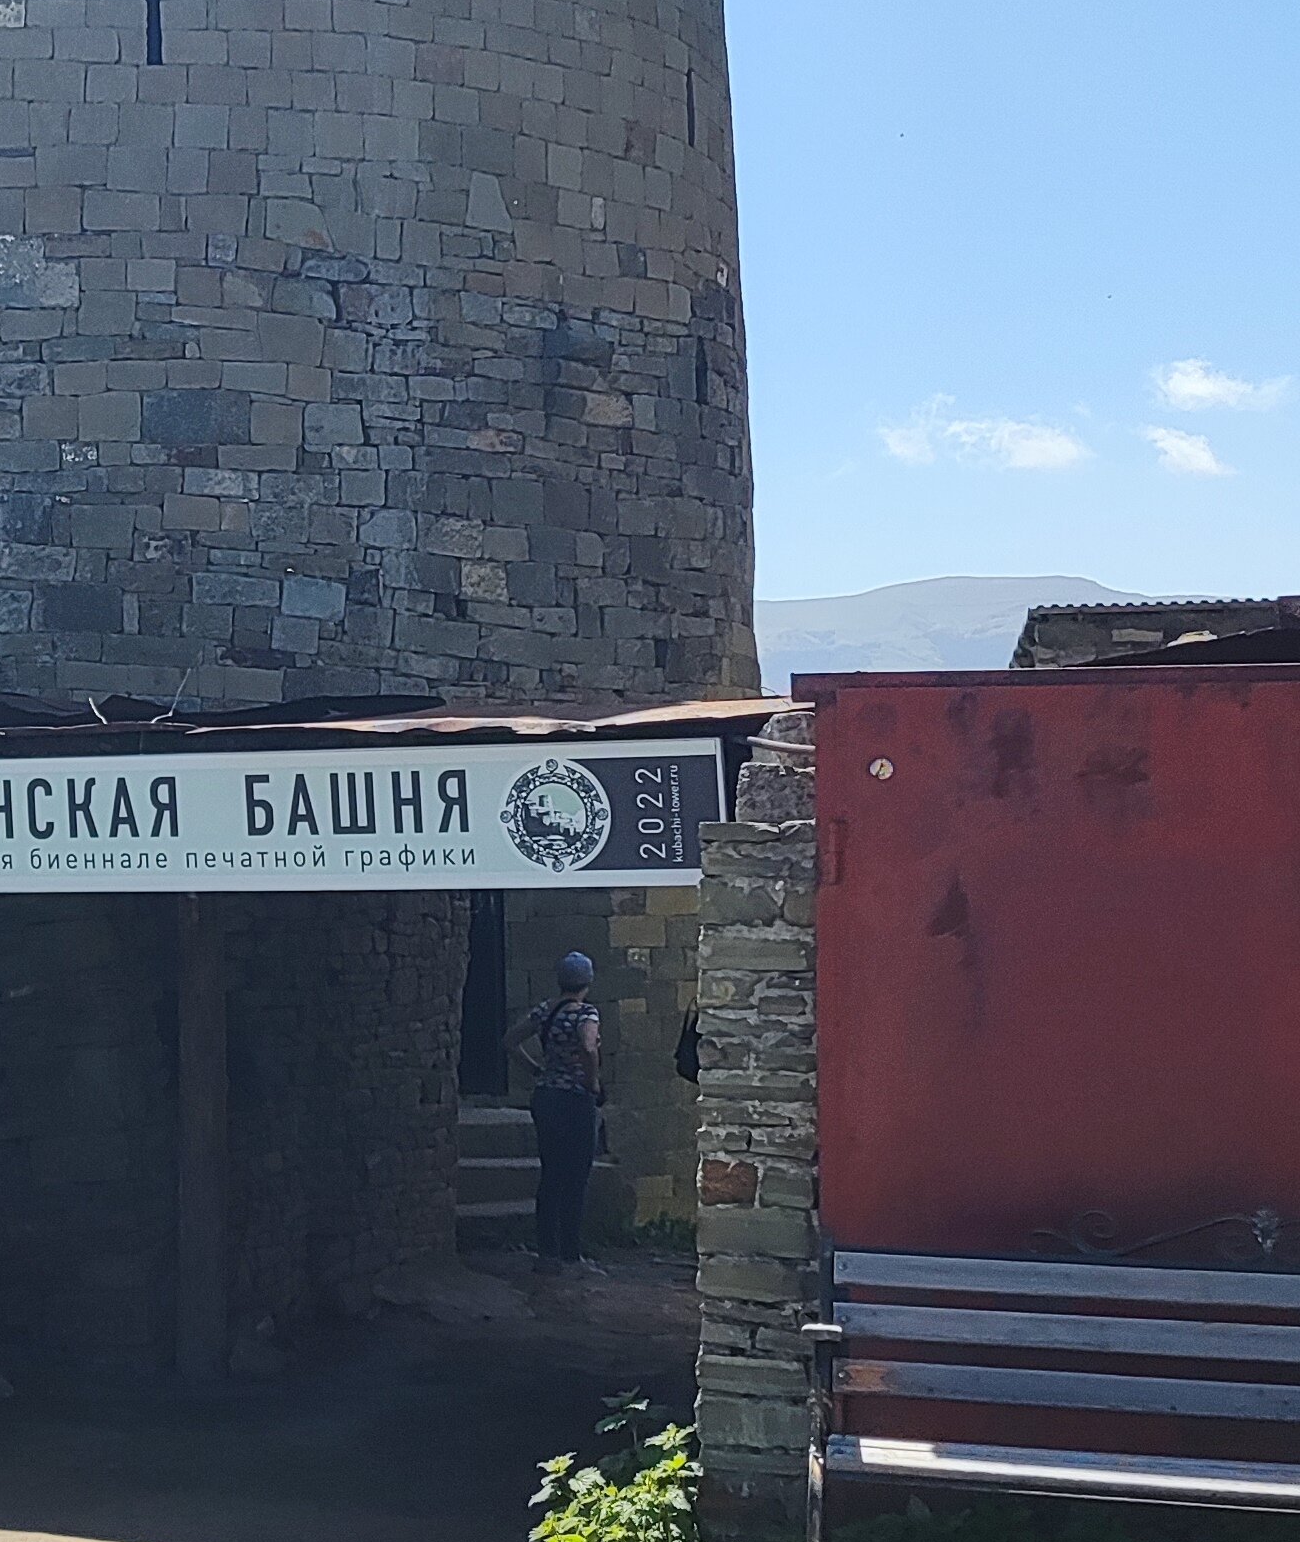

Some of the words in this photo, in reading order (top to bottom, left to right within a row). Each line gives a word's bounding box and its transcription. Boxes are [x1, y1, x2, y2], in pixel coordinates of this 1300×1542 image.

[246, 769, 470, 837] БАШНЯ
[634, 766, 666, 860] 2022
[671, 764, 684, 863] kubachi-tower.ru
[29, 846, 169, 871] биеннале
[186, 844, 326, 869] печатной
[344, 843, 475, 871] графики
